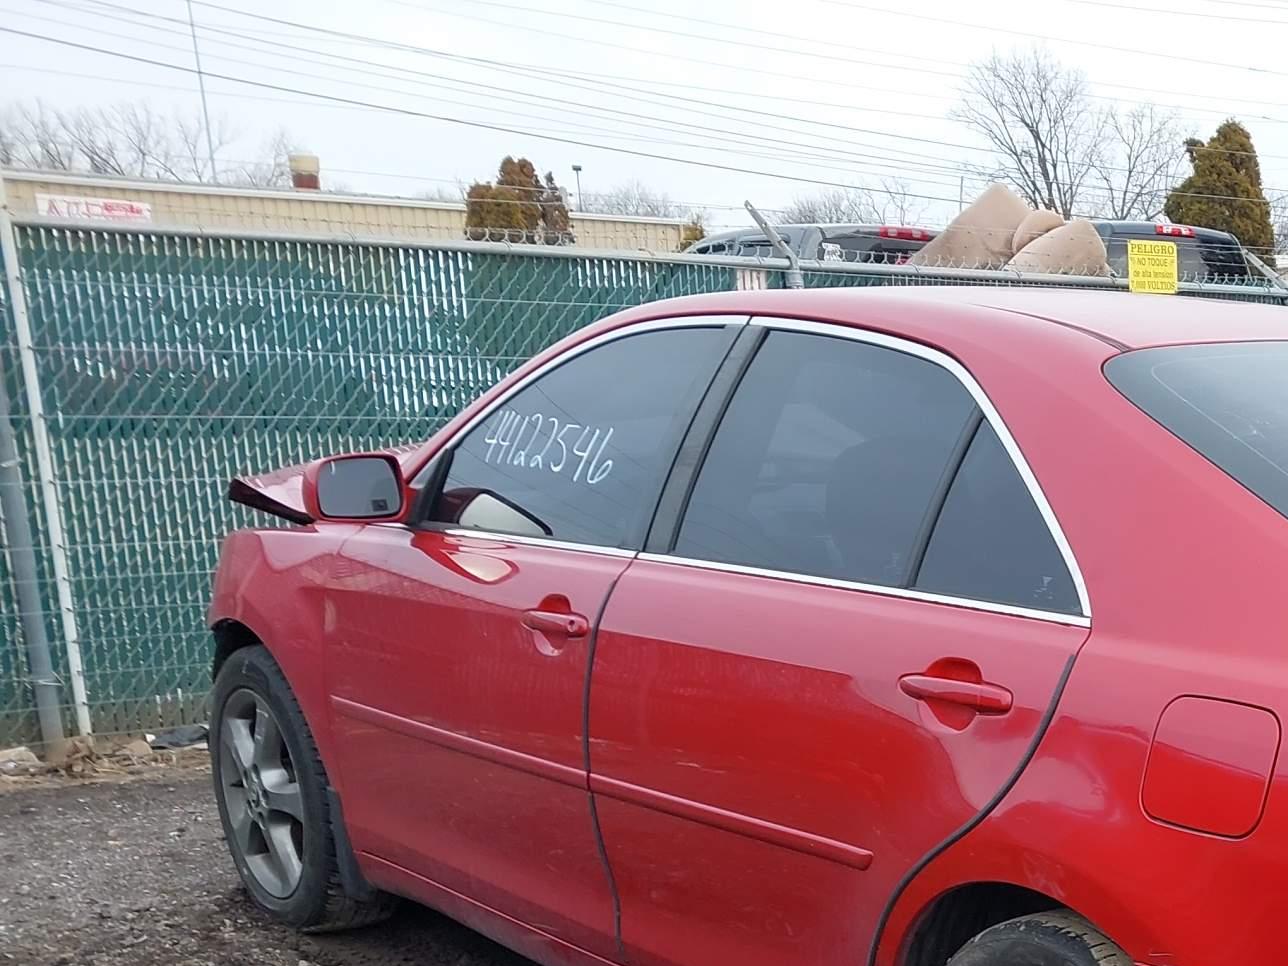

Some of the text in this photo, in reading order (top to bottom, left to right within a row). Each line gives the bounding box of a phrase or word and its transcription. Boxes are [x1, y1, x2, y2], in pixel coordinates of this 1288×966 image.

[1130, 243, 1175, 255] PELIGRO
[1137, 257, 1168, 267] NO TOQUE
[1147, 280, 1175, 291] VOLTIOS
[484, 410, 614, 484] 44122546
